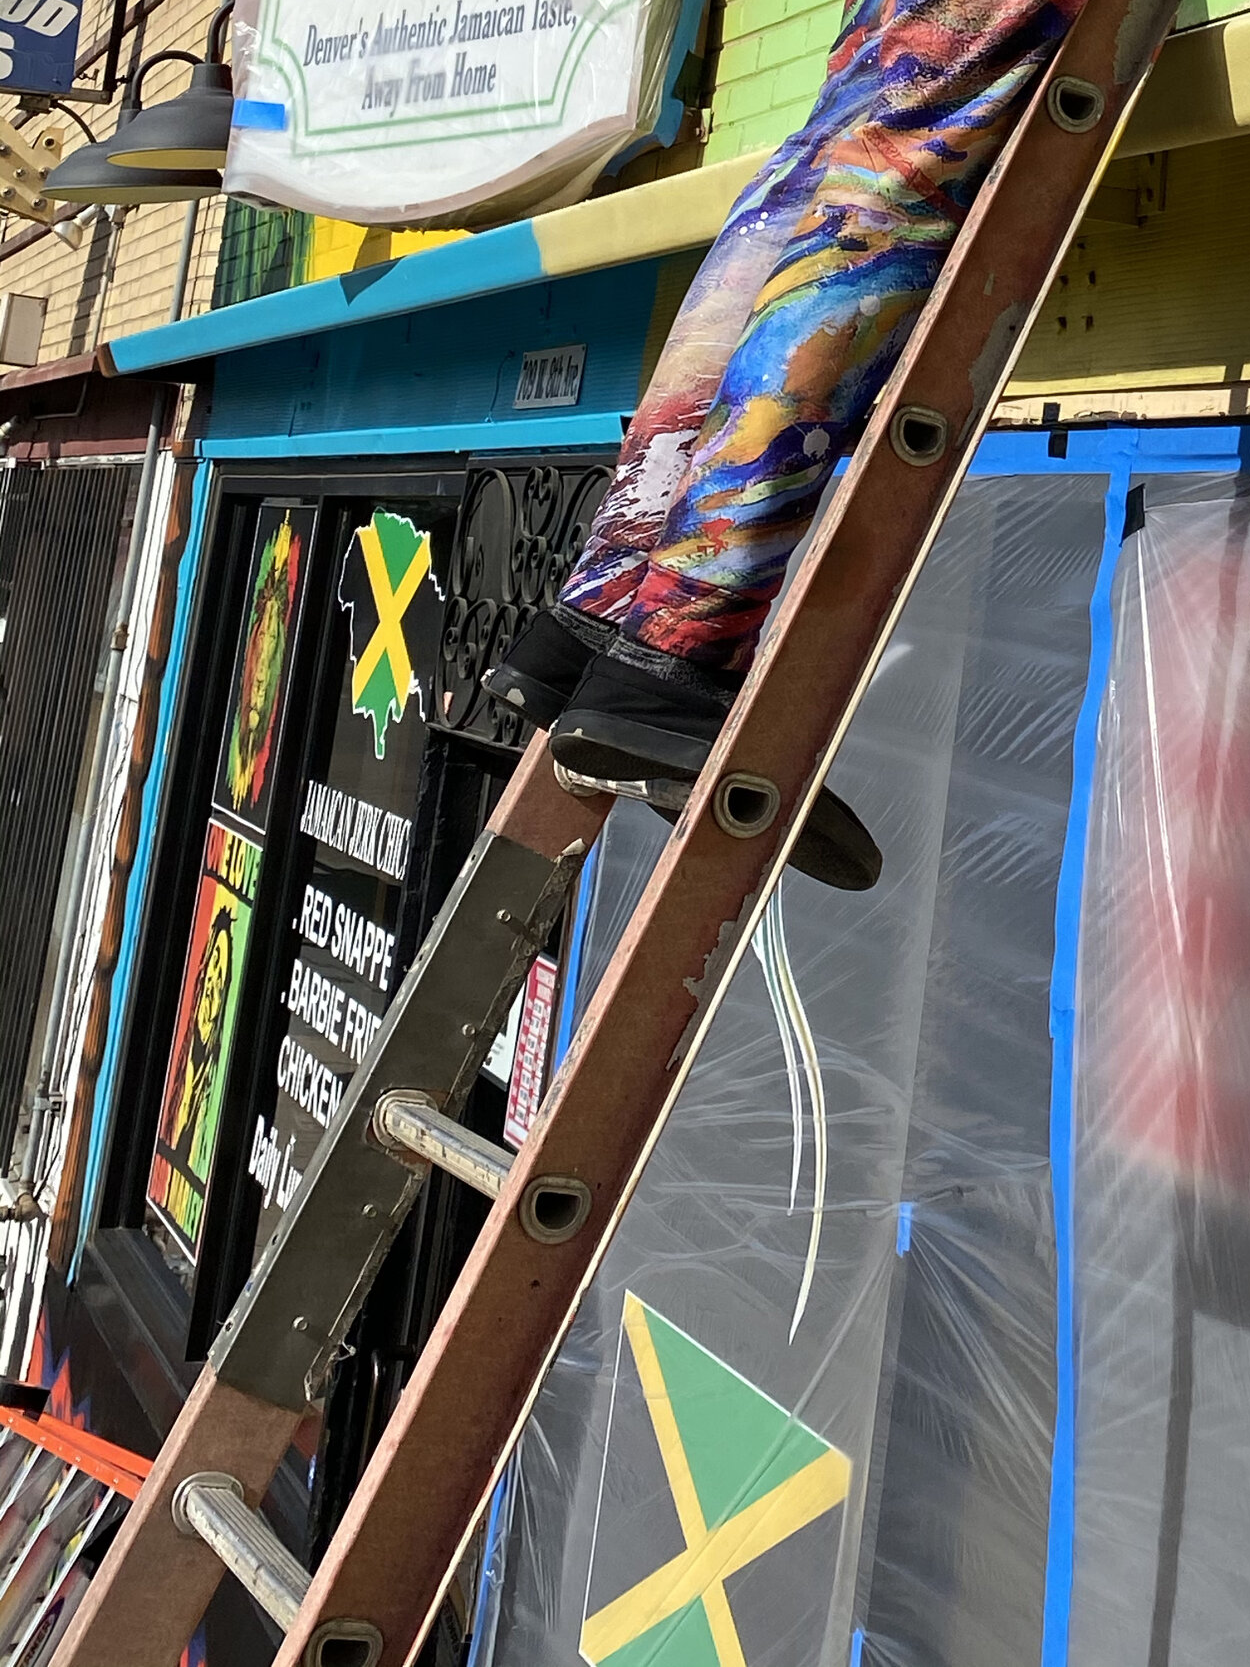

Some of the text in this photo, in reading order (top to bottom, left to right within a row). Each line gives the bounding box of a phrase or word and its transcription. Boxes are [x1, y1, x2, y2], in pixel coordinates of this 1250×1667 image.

[303, 18, 368, 66] Denver's
[369, 5, 446, 56] Authentic
[361, 52, 496, 117] Away From Home
[207, 823, 262, 901] ONE LOVE
[300, 780, 356, 853] JAMAICAN
[348, 800, 383, 866] JERK
[277, 1035, 344, 1129] CHICKEN
[248, 1114, 281, 1210] Daily
